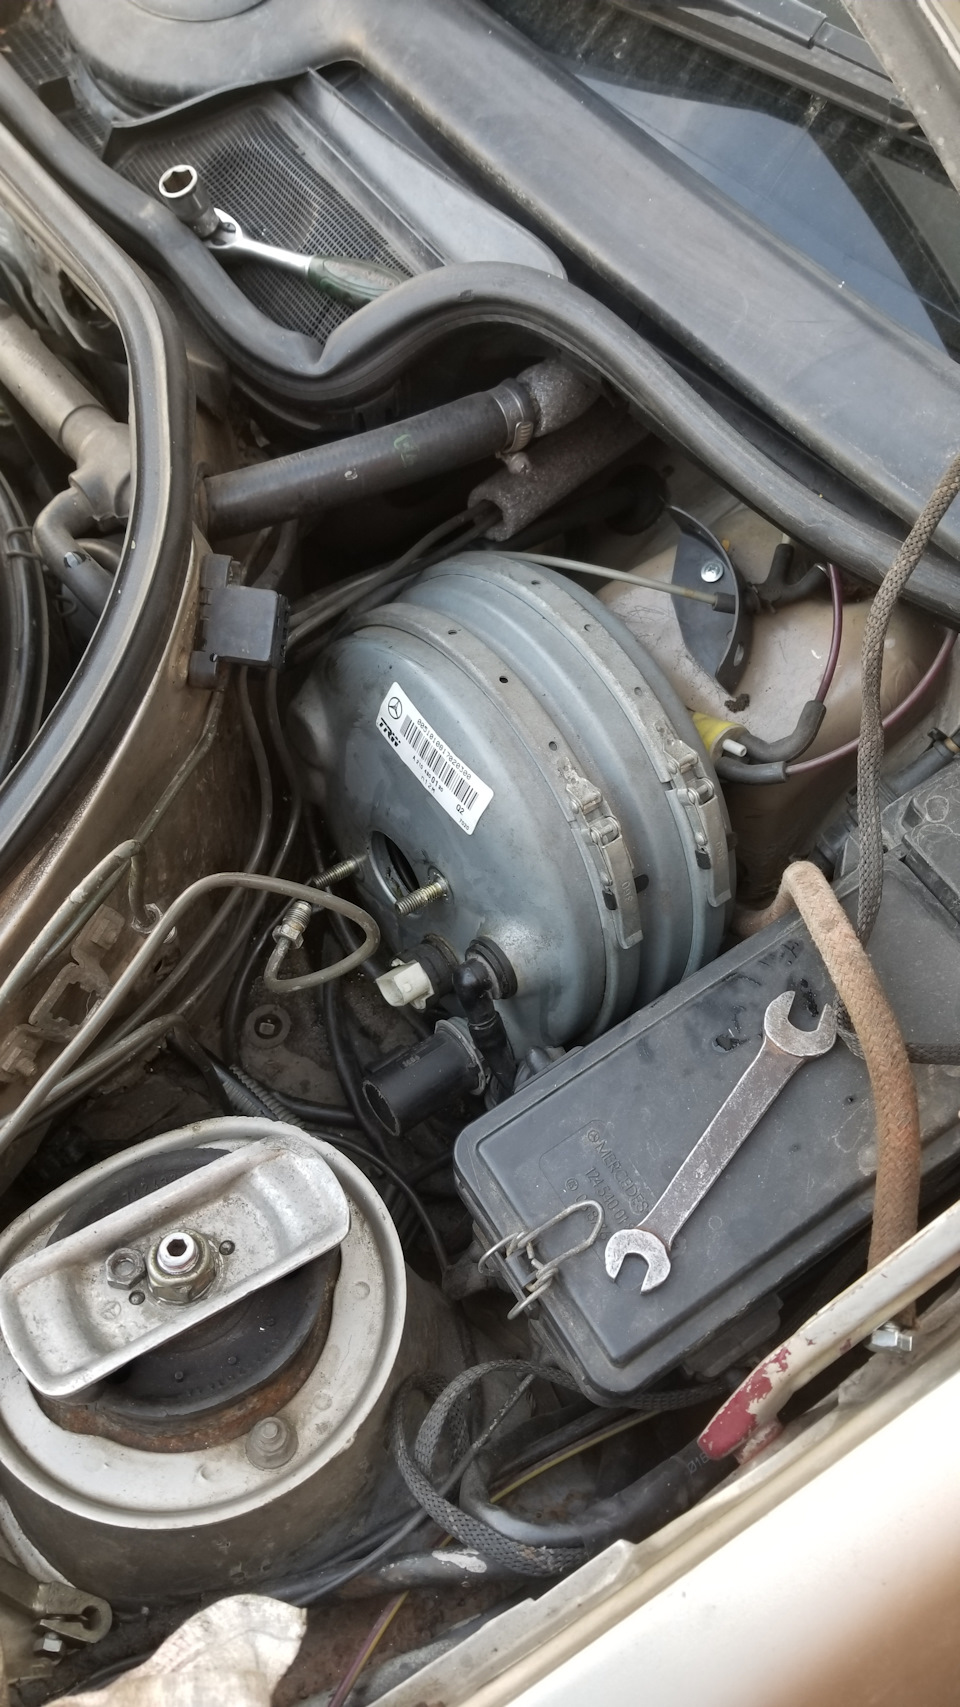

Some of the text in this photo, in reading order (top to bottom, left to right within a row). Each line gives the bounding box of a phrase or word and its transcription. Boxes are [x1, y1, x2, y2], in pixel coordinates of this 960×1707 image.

[455, 803, 465, 815] Q2
[585, 1166, 604, 1188] 124
[598, 1185, 620, 1211] 540
[595, 1140, 649, 1214] MERCEDES
